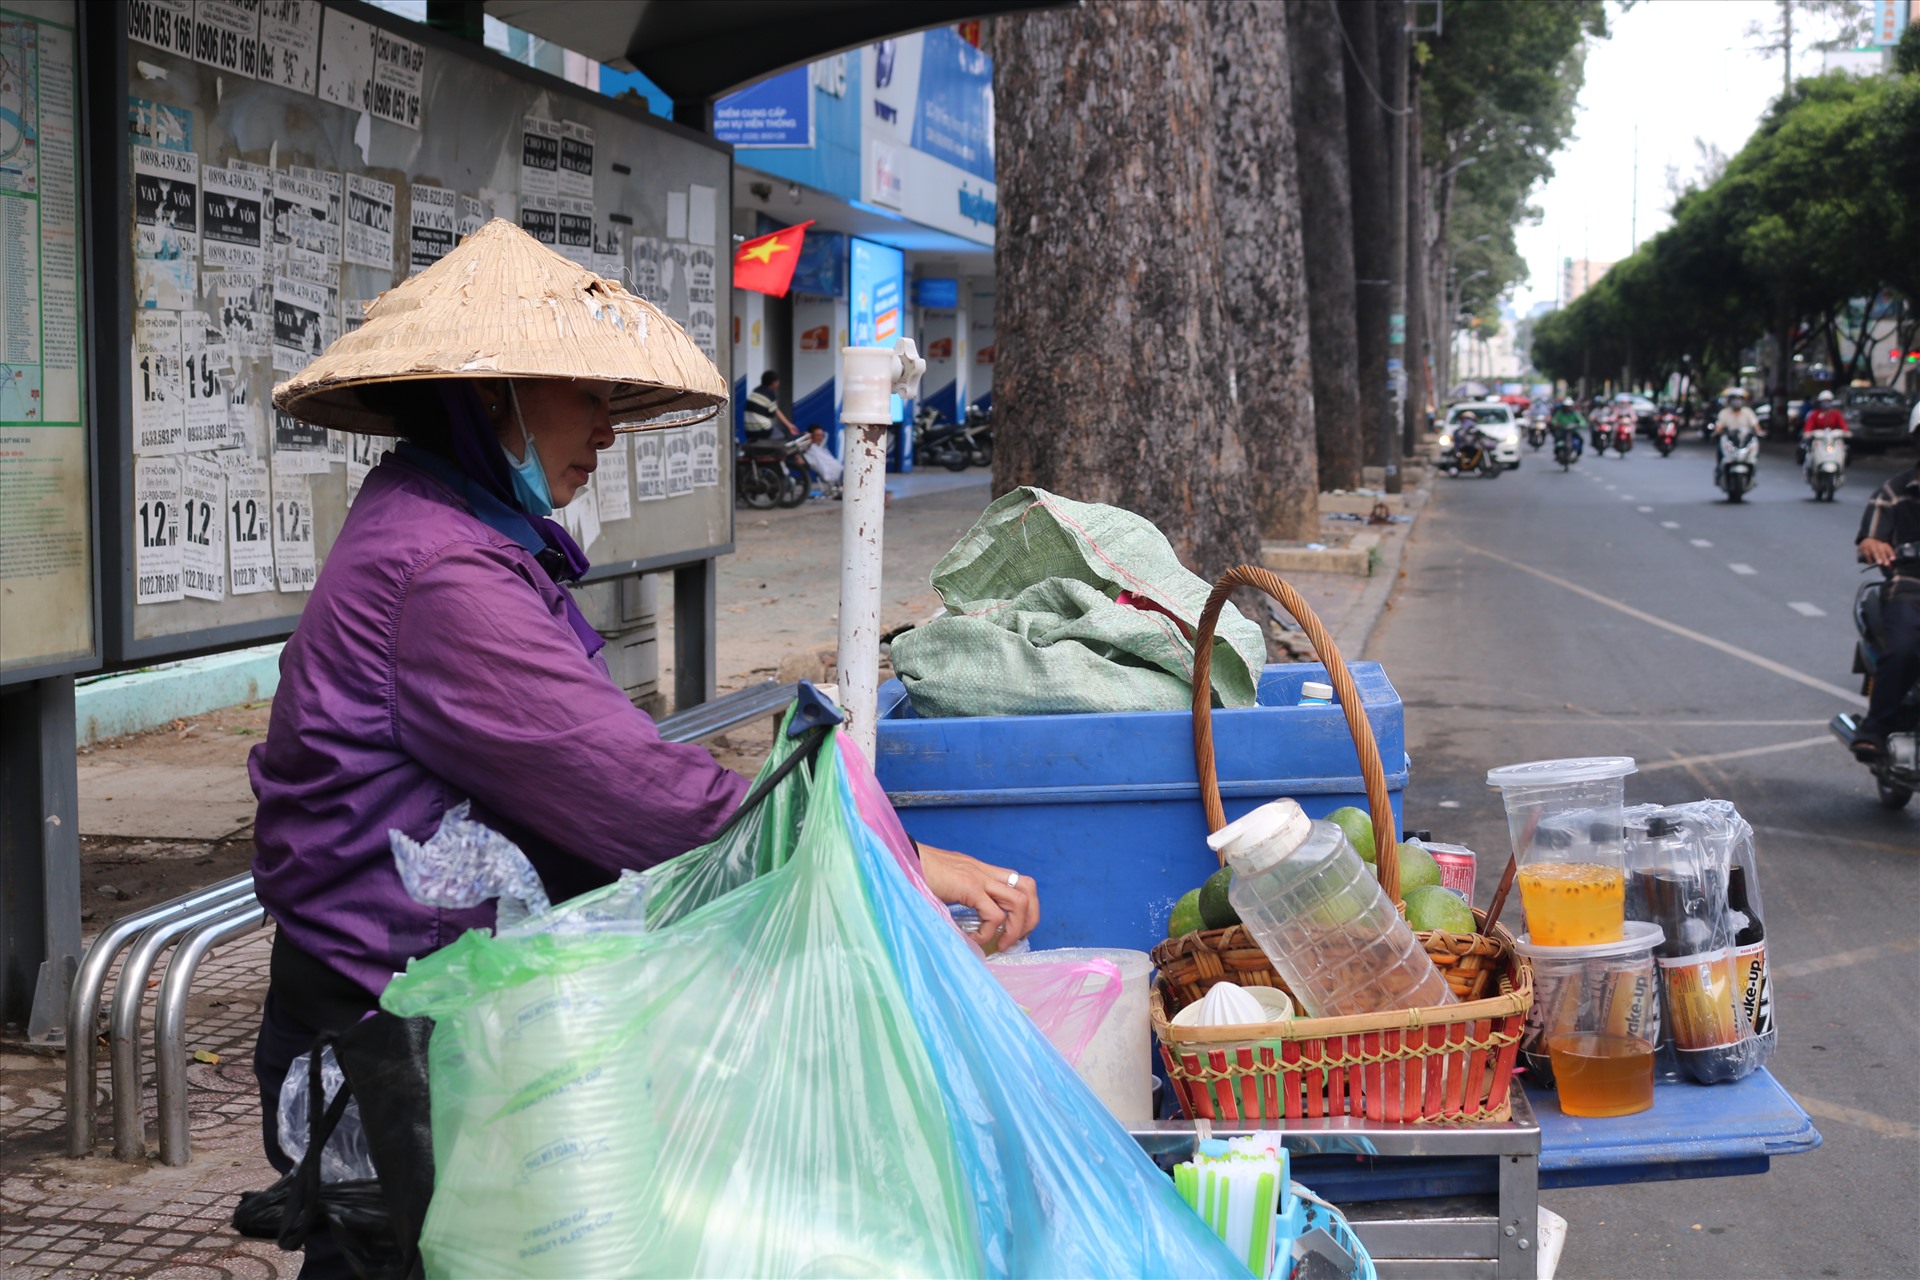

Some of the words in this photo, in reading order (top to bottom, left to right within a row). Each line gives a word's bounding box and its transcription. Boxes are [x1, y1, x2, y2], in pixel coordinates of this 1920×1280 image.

[128, 0, 151, 41] 0906
[154, 6, 171, 48] 053
[174, 14, 191, 54] 166
[195, 22, 218, 63] 0906
[220, 30, 237, 69] 053
[240, 36, 256, 75] 166
[378, 36, 390, 61] CHO
[374, 82, 392, 117] 0906
[392, 88, 405, 121] 053
[525, 136, 542, 150] CHO
[562, 140, 578, 154] CHO
[140, 149, 192, 174] 0898.439.826
[540, 155, 556, 170] GÓP
[576, 160, 591, 174] GÓP
[208, 168, 257, 192] 0898.439.826
[279, 179, 323, 202] 0898.439.826
[349, 175, 394, 203] 090.332.5672
[141, 185, 159, 202] VAY
[173, 189, 191, 208] VỐN
[412, 186, 455, 209] 0909.622.058
[208, 202, 225, 219] VAY
[239, 207, 256, 224] VỐN
[349, 196, 370, 224] VAY
[370, 203, 392, 234] VỐN
[413, 209, 432, 228] VAY
[434, 208, 453, 231] VỐN
[523, 212, 540, 225] CHO
[540, 213, 556, 226] VAY
[560, 215, 576, 228] CHO
[576, 217, 590, 230] VAY
[539, 227, 555, 243] GÓP
[561, 230, 575, 244] TRẢ
[574, 232, 590, 246] GÓP
[208, 244, 256, 265] 0898.439.826
[346, 232, 391, 263] 090.332.5672
[278, 310, 295, 327] VAY
[280, 416, 295, 430] VAY
[139, 501, 167, 548] 1.2
[185, 498, 211, 547] 1.2
[232, 499, 258, 542] 1.2
[277, 501, 301, 542] 1.2
[1745, 960, 1762, 1023] ake-up
[595, 1212, 615, 1228] CUP
